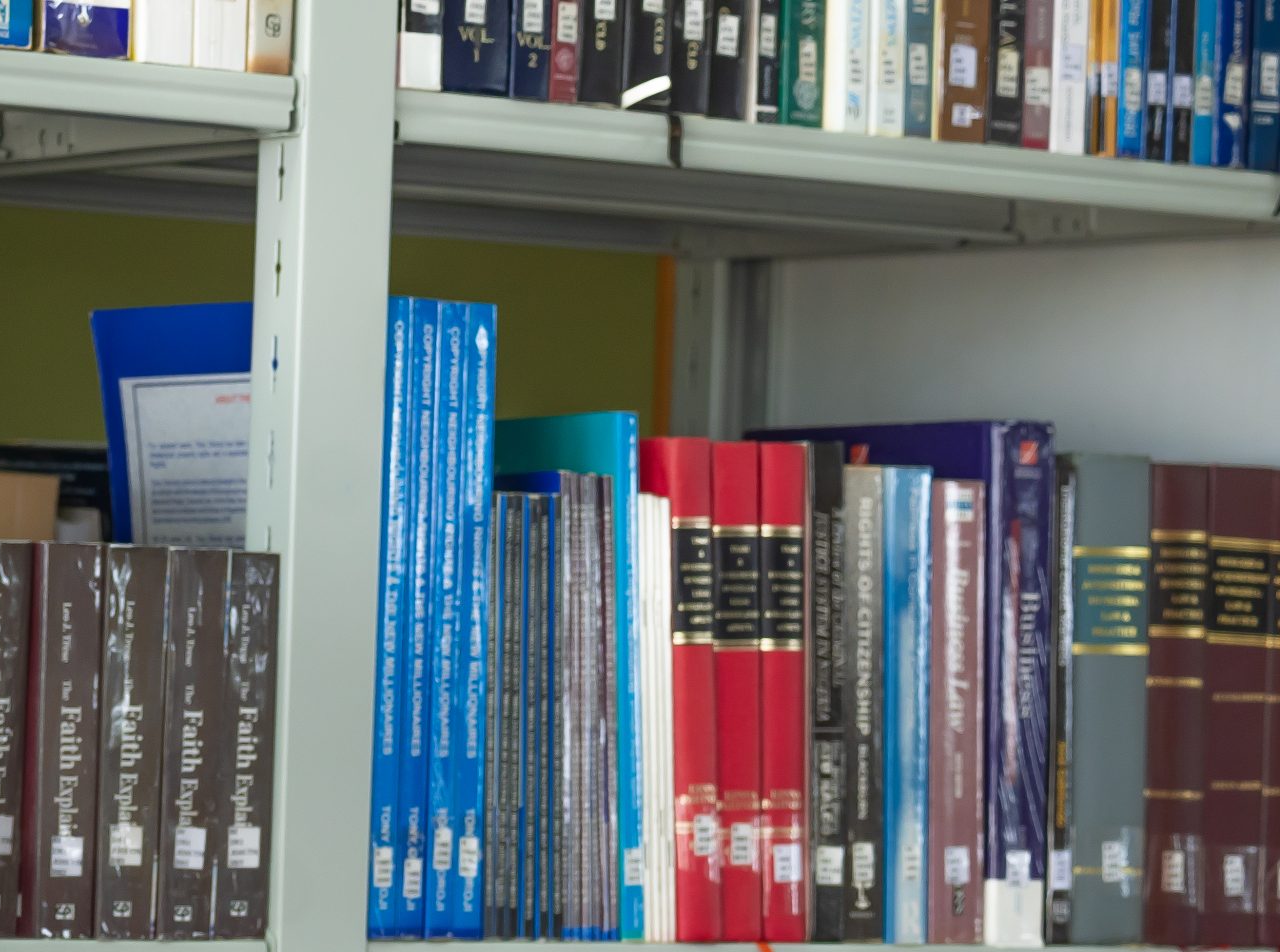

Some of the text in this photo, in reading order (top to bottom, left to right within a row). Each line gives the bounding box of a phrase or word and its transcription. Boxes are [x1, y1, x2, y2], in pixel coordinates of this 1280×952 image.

[858, 496, 874, 571] RIGHTS
[857, 574, 873, 602] OF
[856, 607, 873, 736] CITIZENSHIP
[1019, 591, 1041, 720] Business
[59, 706, 82, 769] Faith
[120, 704, 143, 767] Faith
[180, 709, 204, 773] Faith
[235, 706, 259, 768] Faith
